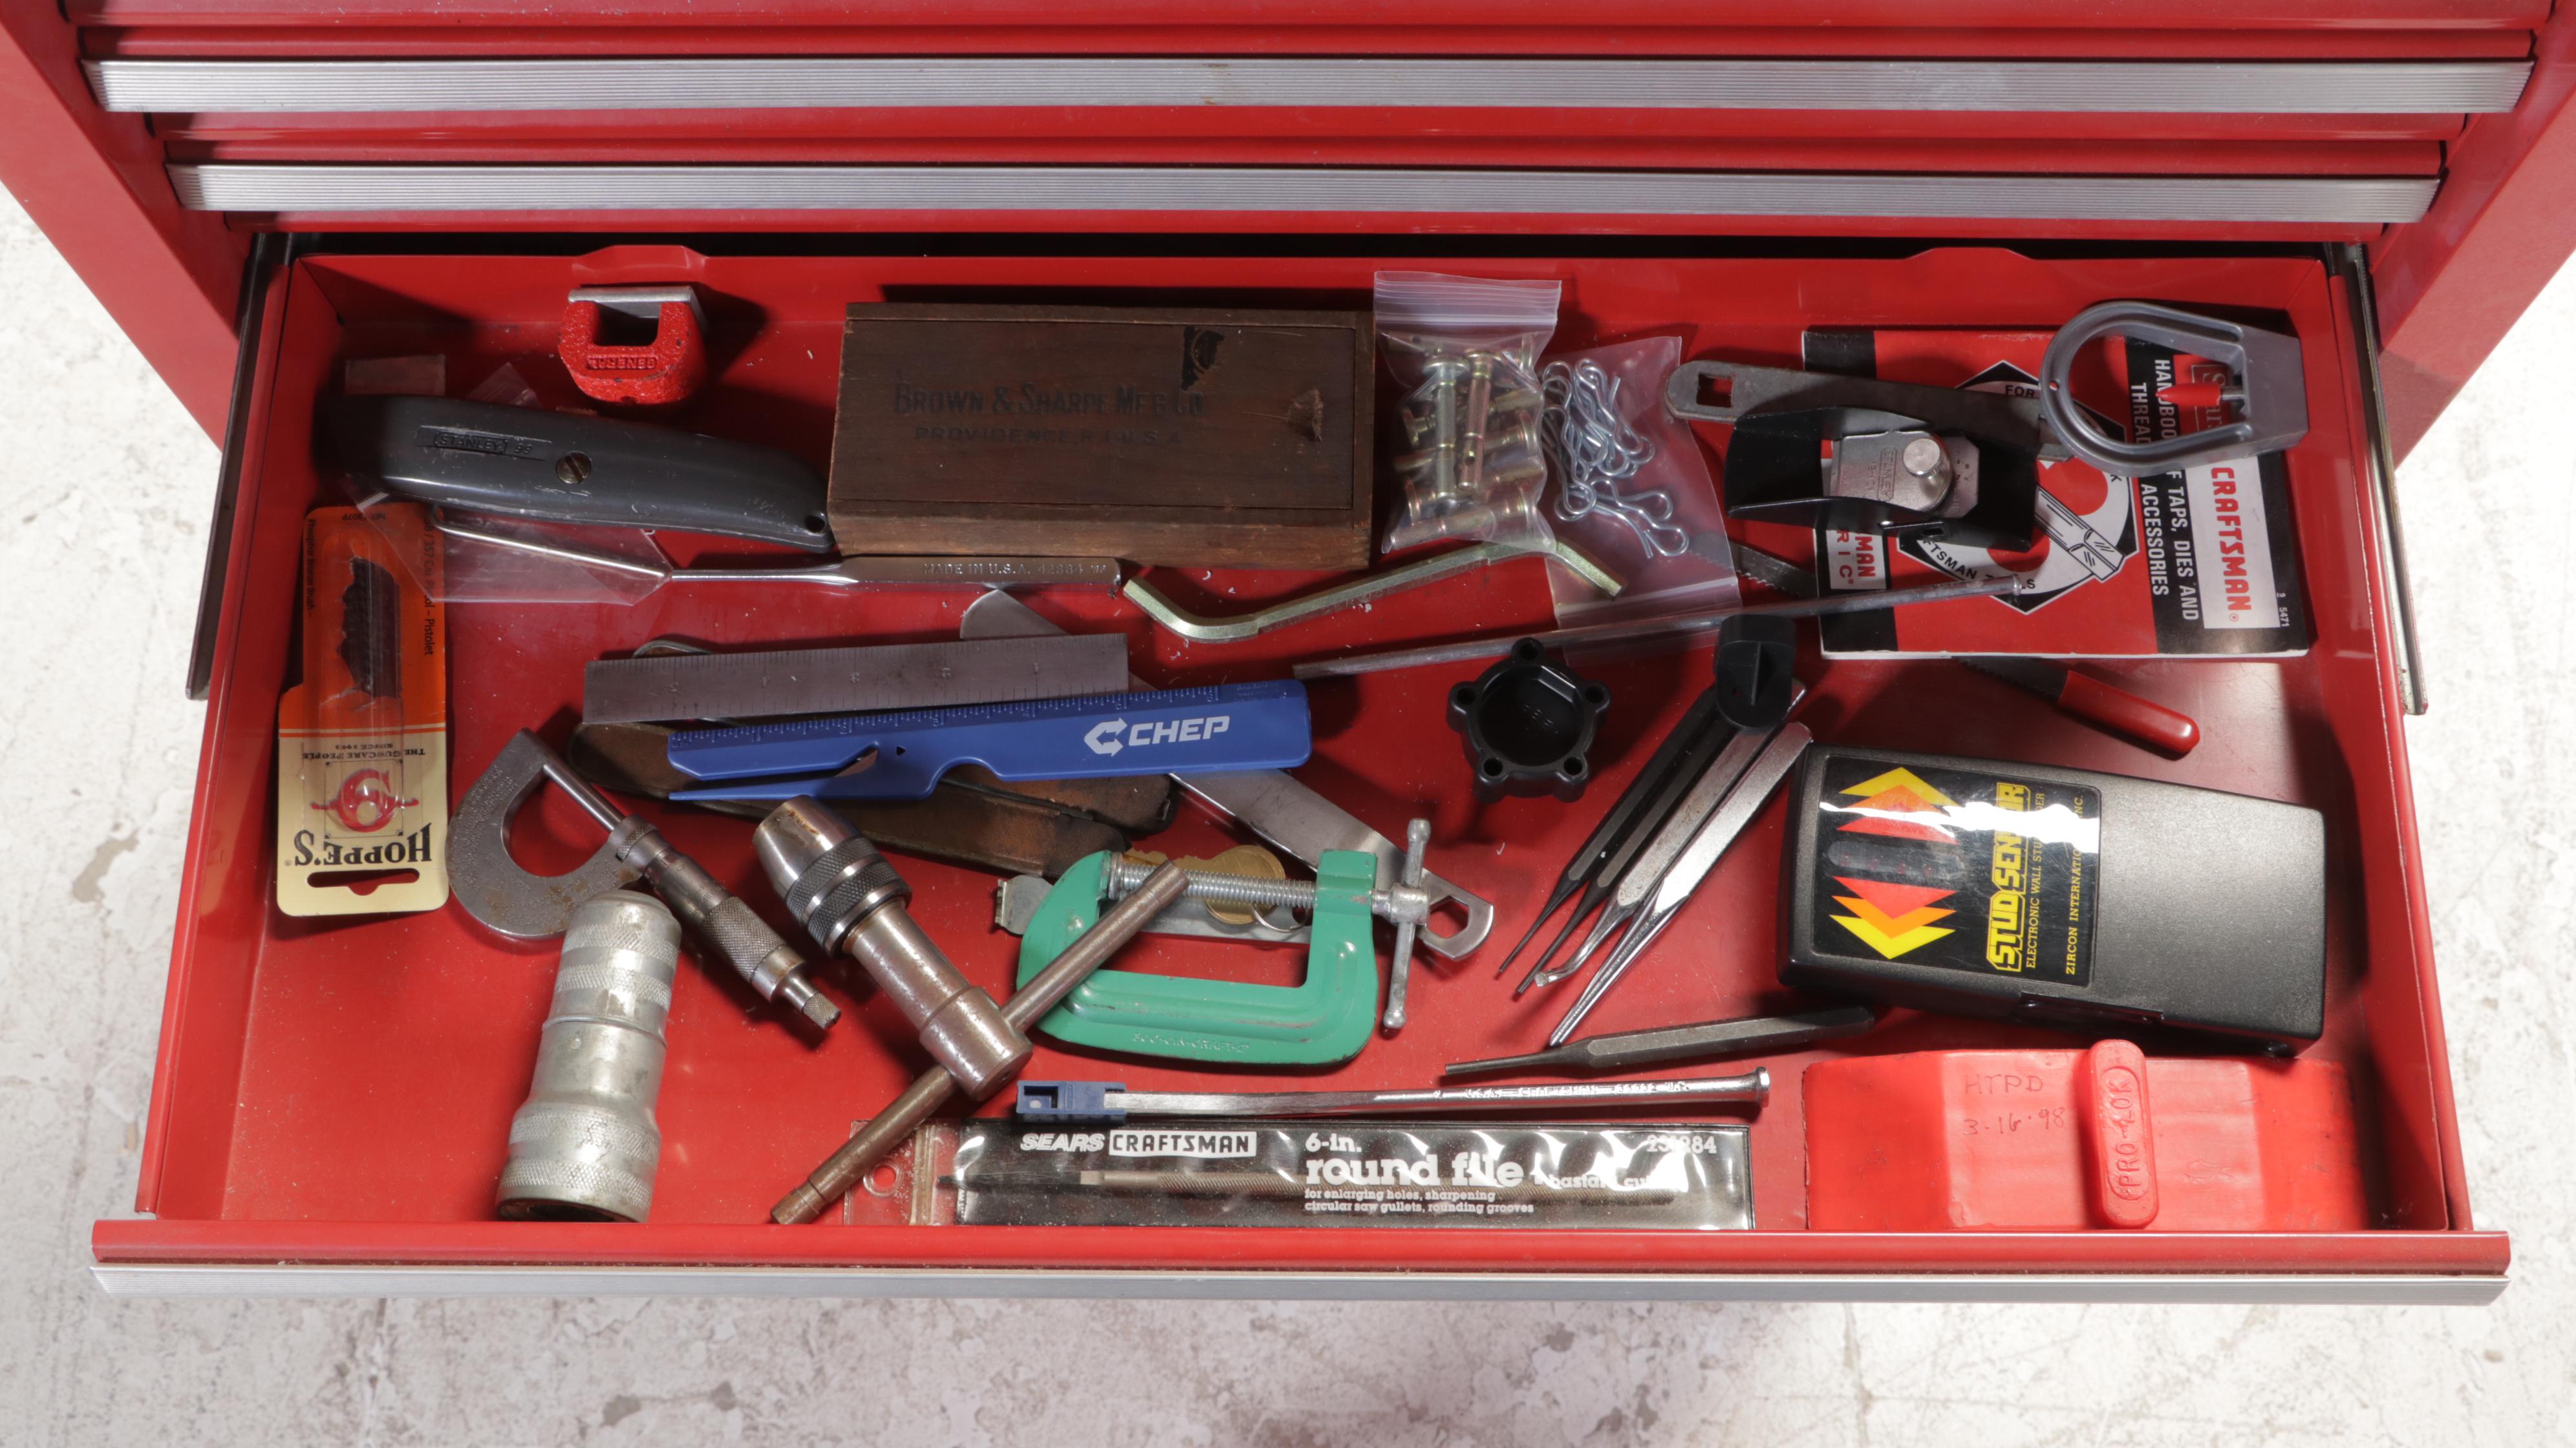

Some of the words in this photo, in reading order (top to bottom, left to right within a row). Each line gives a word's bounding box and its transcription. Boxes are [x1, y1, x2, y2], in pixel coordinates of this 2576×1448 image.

[2005, 385, 2035, 398] FOR
[2154, 359, 2177, 440] HANBOO
[438, 434, 501, 451] STANLEY
[1881, 449, 1894, 498] STANLEY
[2168, 487, 2188, 532] TAPS,
[2141, 484, 2169, 595] ACCESSORIES
[2211, 467, 2251, 611] CRAFTSMAN
[923, 563, 963, 574] MADE
[989, 563, 1031, 574] U.S.A.
[2174, 540, 2194, 577] DIES
[2179, 584, 2199, 621] AND
[424, 618, 435, 655] Pistolet
[1128, 716, 1230, 747] CHEP
[2030, 866, 2043, 895] WALL
[2026, 897, 2040, 968] ELECTRONIC
[2066, 926, 2077, 975] ZIRCON
[1020, 1133, 1105, 1152] SEARS
[1113, 1134, 1249, 1153] CRAFTSMAN
[1305, 1133, 1362, 1153] 6-in.
[1306, 1154, 1441, 1186] round
[1451, 1151, 1525, 1187] file
[1304, 1200, 1353, 1211] circular
[1354, 1202, 1379, 1212] saw
[1380, 1201, 1426, 1213] gullets,
[1427, 1200, 1485, 1213] rounding
[1487, 1203, 1534, 1214] grooves
[1305, 1189, 1322, 1199] for
[1324, 1189, 1384, 1202] enlarging
[1386, 1189, 1424, 1201] holes,
[1425, 1189, 1496, 1202] sharpening
